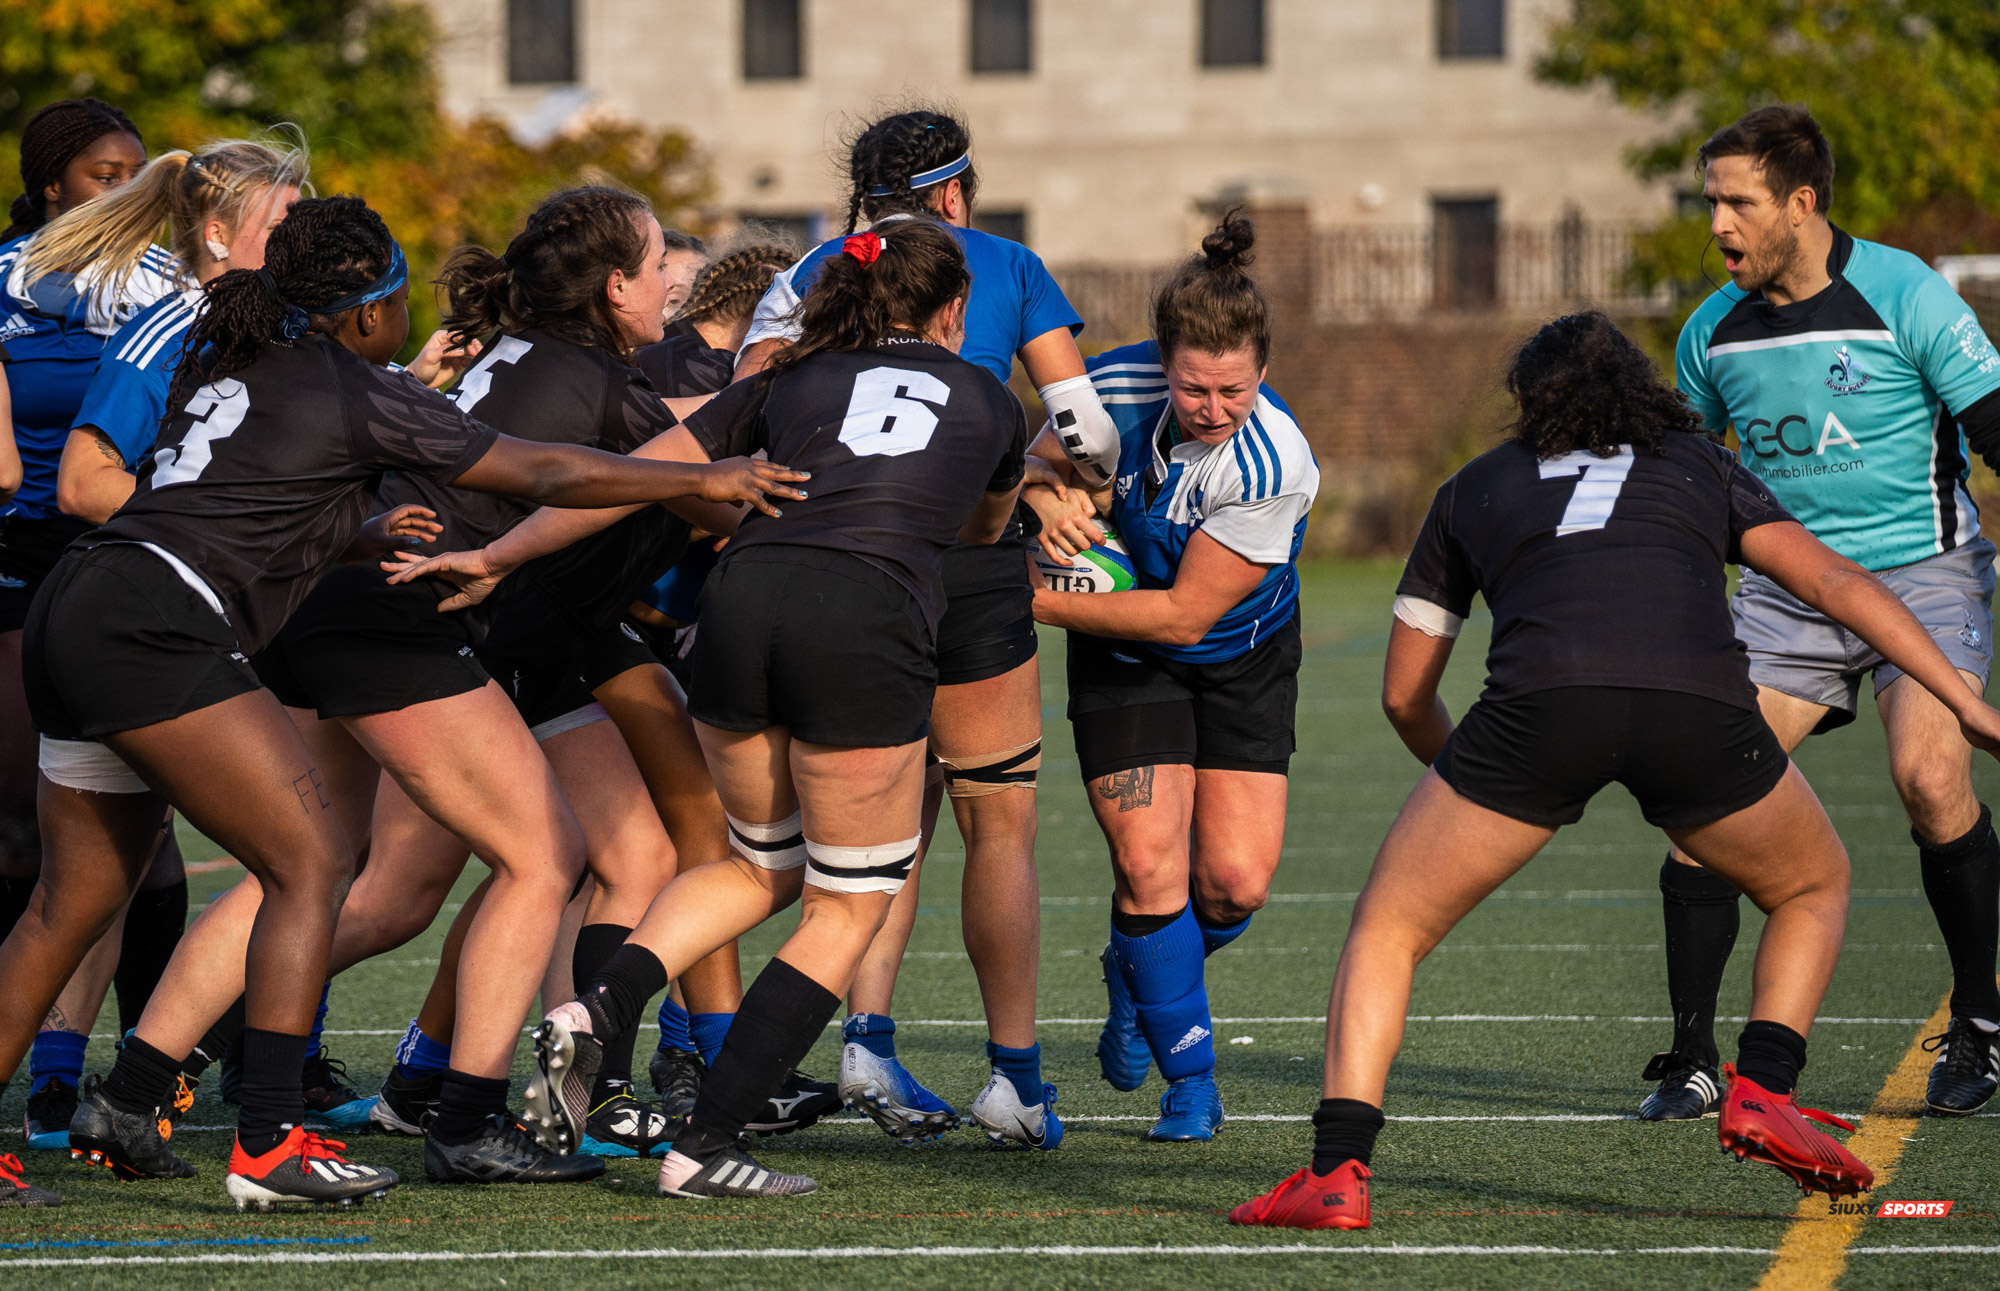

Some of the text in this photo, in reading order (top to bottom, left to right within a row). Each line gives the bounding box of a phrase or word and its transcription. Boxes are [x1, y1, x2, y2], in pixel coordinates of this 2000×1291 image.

[445, 335, 534, 413] 5
[837, 366, 951, 457] 6
[151, 377, 250, 490] 3
[1537, 443, 1635, 537] 7
